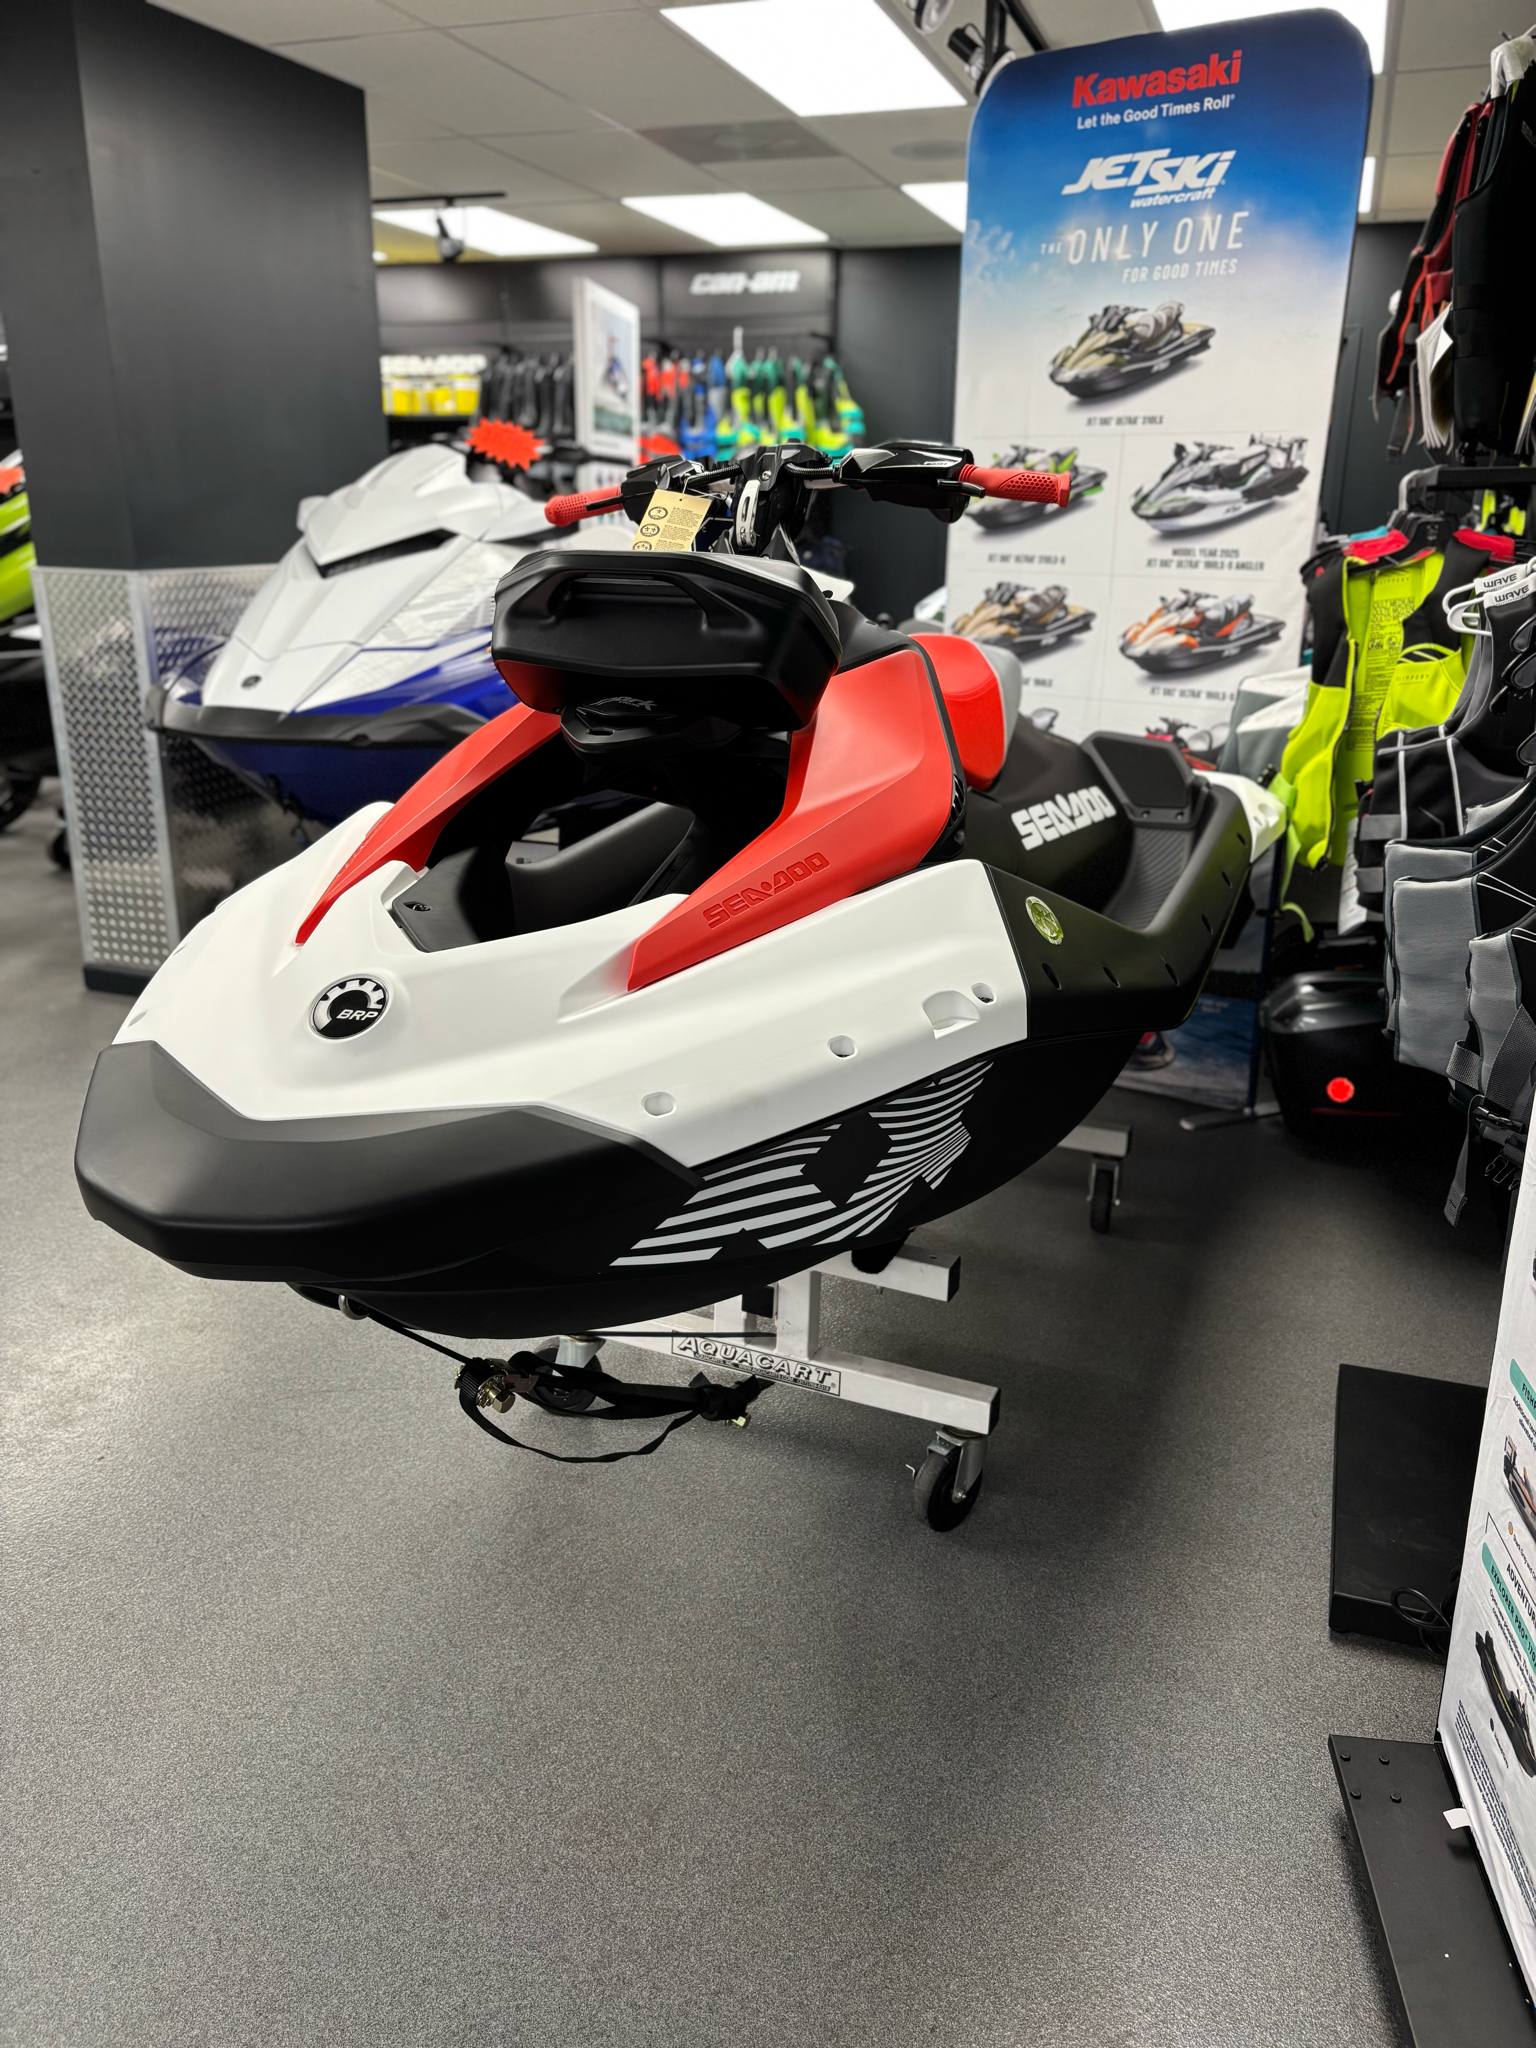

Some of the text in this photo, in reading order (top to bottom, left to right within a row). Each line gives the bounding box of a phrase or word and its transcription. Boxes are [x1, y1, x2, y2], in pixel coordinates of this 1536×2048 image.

[1072, 49, 1243, 109] Kawasaki
[1076, 116, 1097, 130] Let
[1100, 111, 1121, 126] the
[1123, 104, 1159, 123] Good
[1161, 101, 1201, 118] Times
[1130, 187, 1217, 209] watercraft
[1040, 211, 1249, 265] THE ONLY ONE
[1122, 258, 1238, 284] FOR GOOD TIMES
[1483, 573, 1518, 588] WAVE
[1494, 584, 1529, 603] WAVE
[336, 1008, 379, 1021] BRP
[1491, 1564, 1514, 1618] EXPLORER
[1507, 1563, 1536, 1630] ADVENTUR
